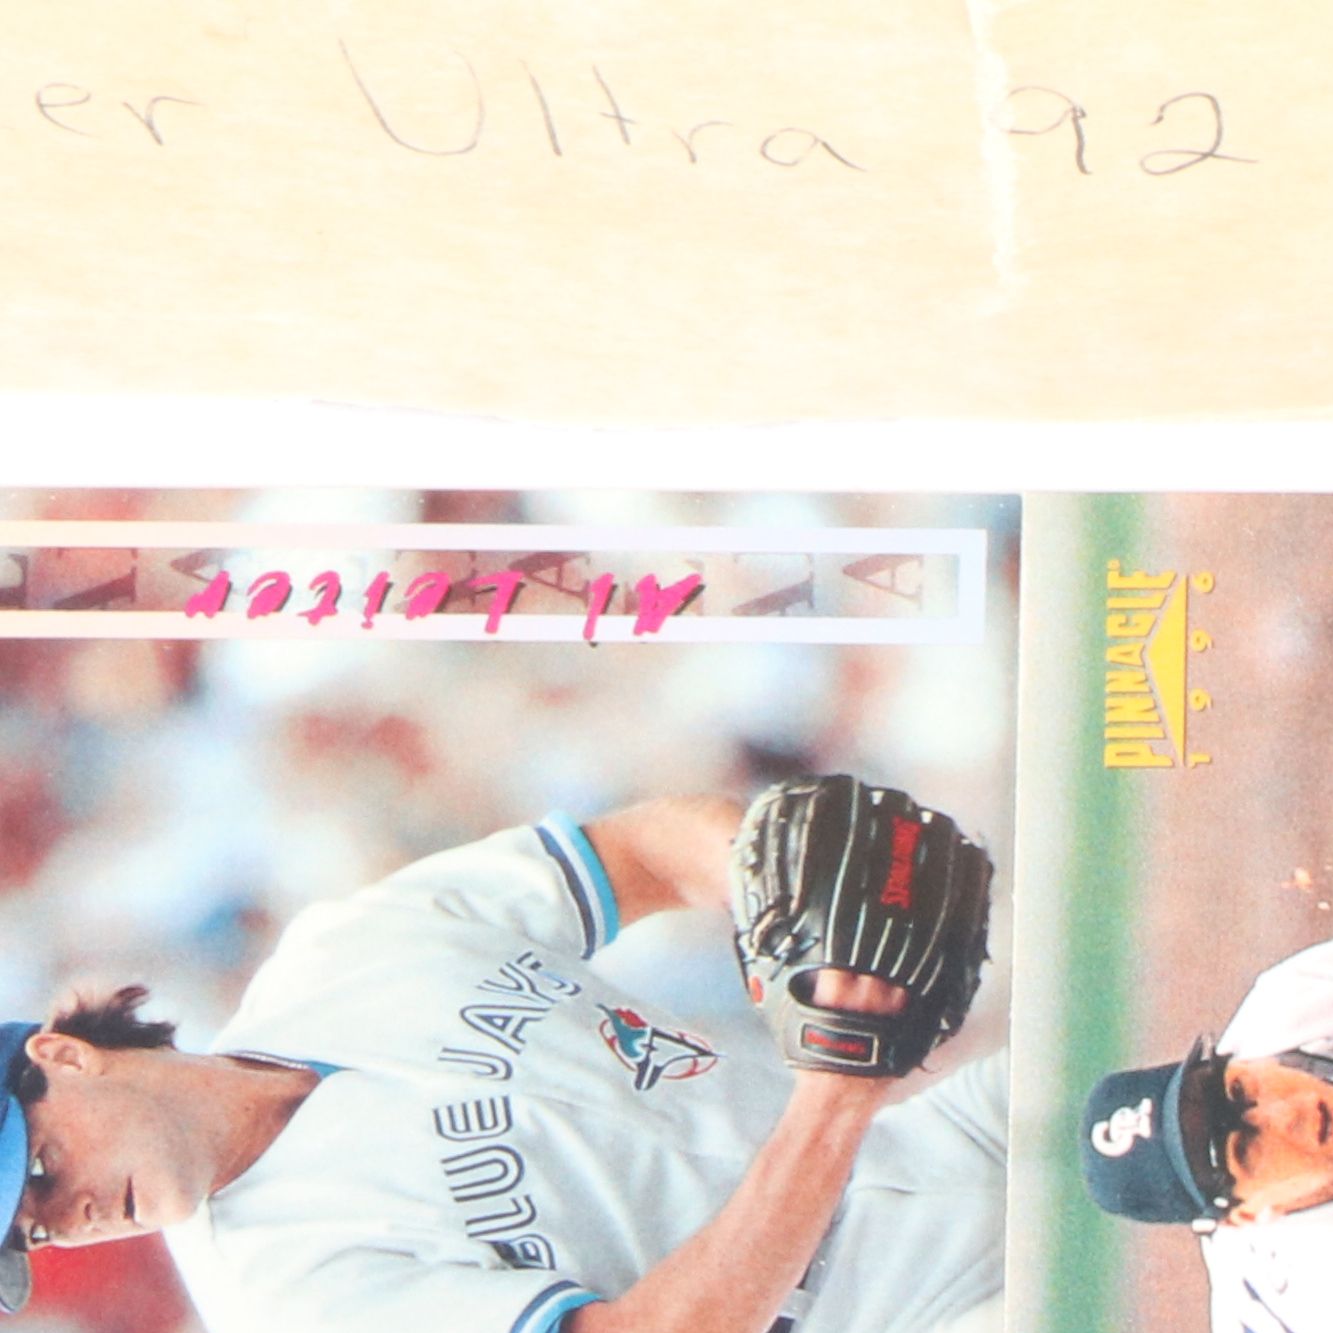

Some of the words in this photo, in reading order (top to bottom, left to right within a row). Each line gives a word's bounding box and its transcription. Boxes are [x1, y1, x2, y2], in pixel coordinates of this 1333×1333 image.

[338, 35, 868, 173] Ultra
[184, 570, 526, 634] Leiter
[1104, 569, 1177, 768] PINNACLE
